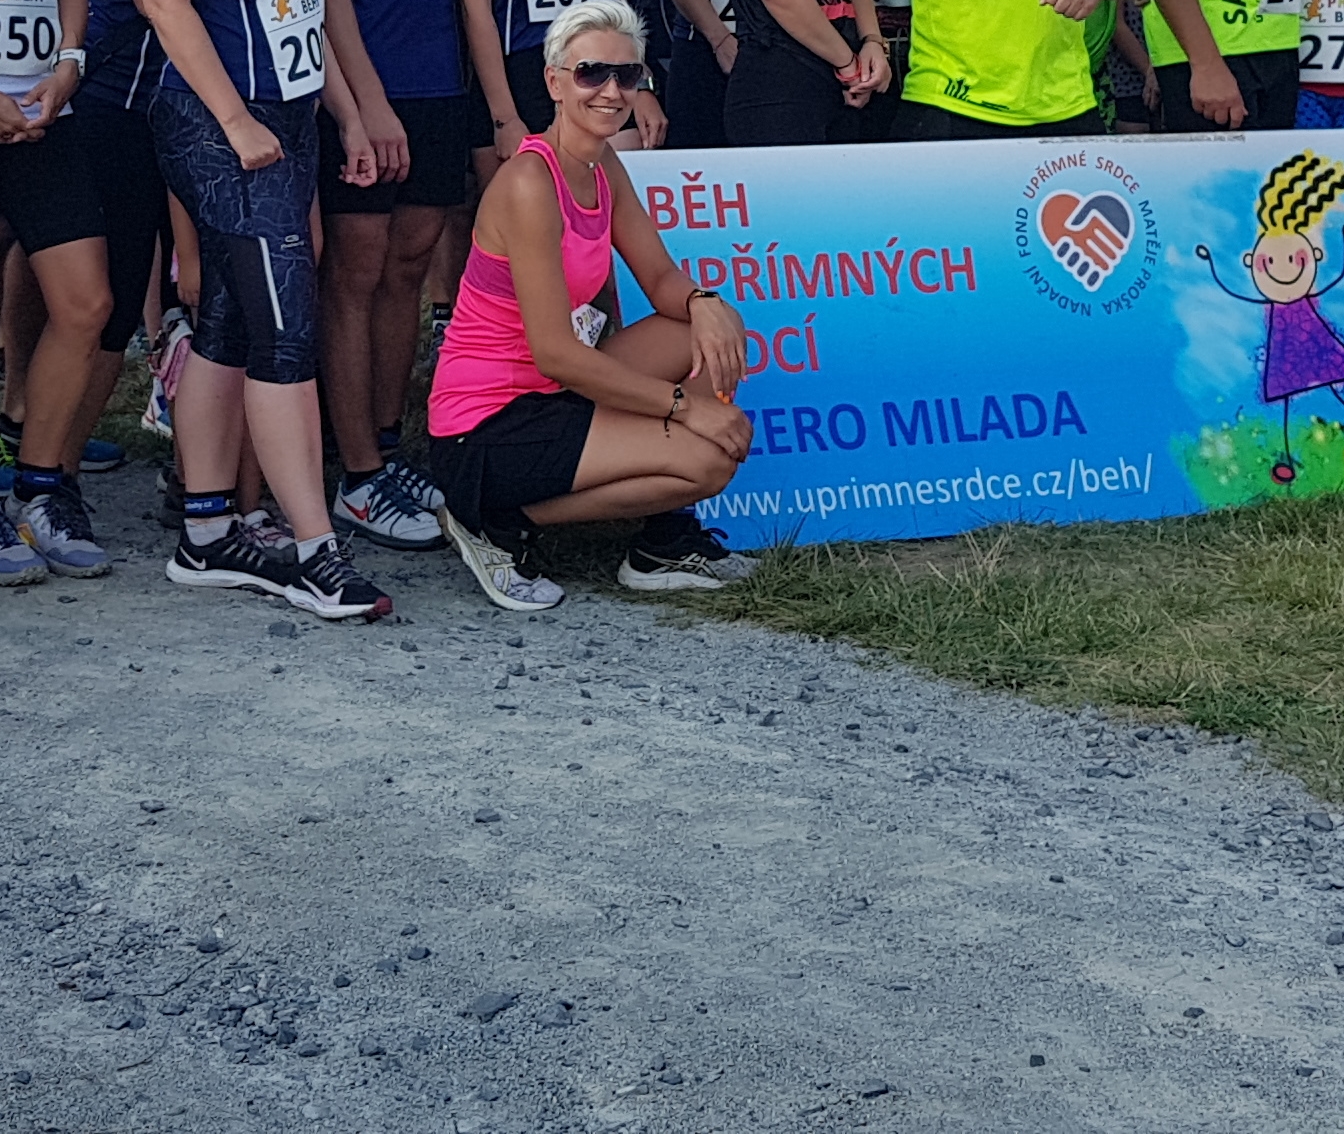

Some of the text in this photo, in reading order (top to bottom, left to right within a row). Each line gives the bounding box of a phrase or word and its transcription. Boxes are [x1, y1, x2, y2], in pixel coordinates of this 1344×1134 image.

[280, 21, 325, 83] 20
[646, 170, 750, 231] BĚH
[1015, 150, 1162, 317] NADAČNÍ FOND UPŘÍMNÉ SRDCE MATĚJE PROŠKA
[745, 312, 820, 376] DCÍ
[742, 390, 1089, 457] ZERO MILADA
[694, 452, 1154, 520] www.uprimnesrdce.cz/beh/
